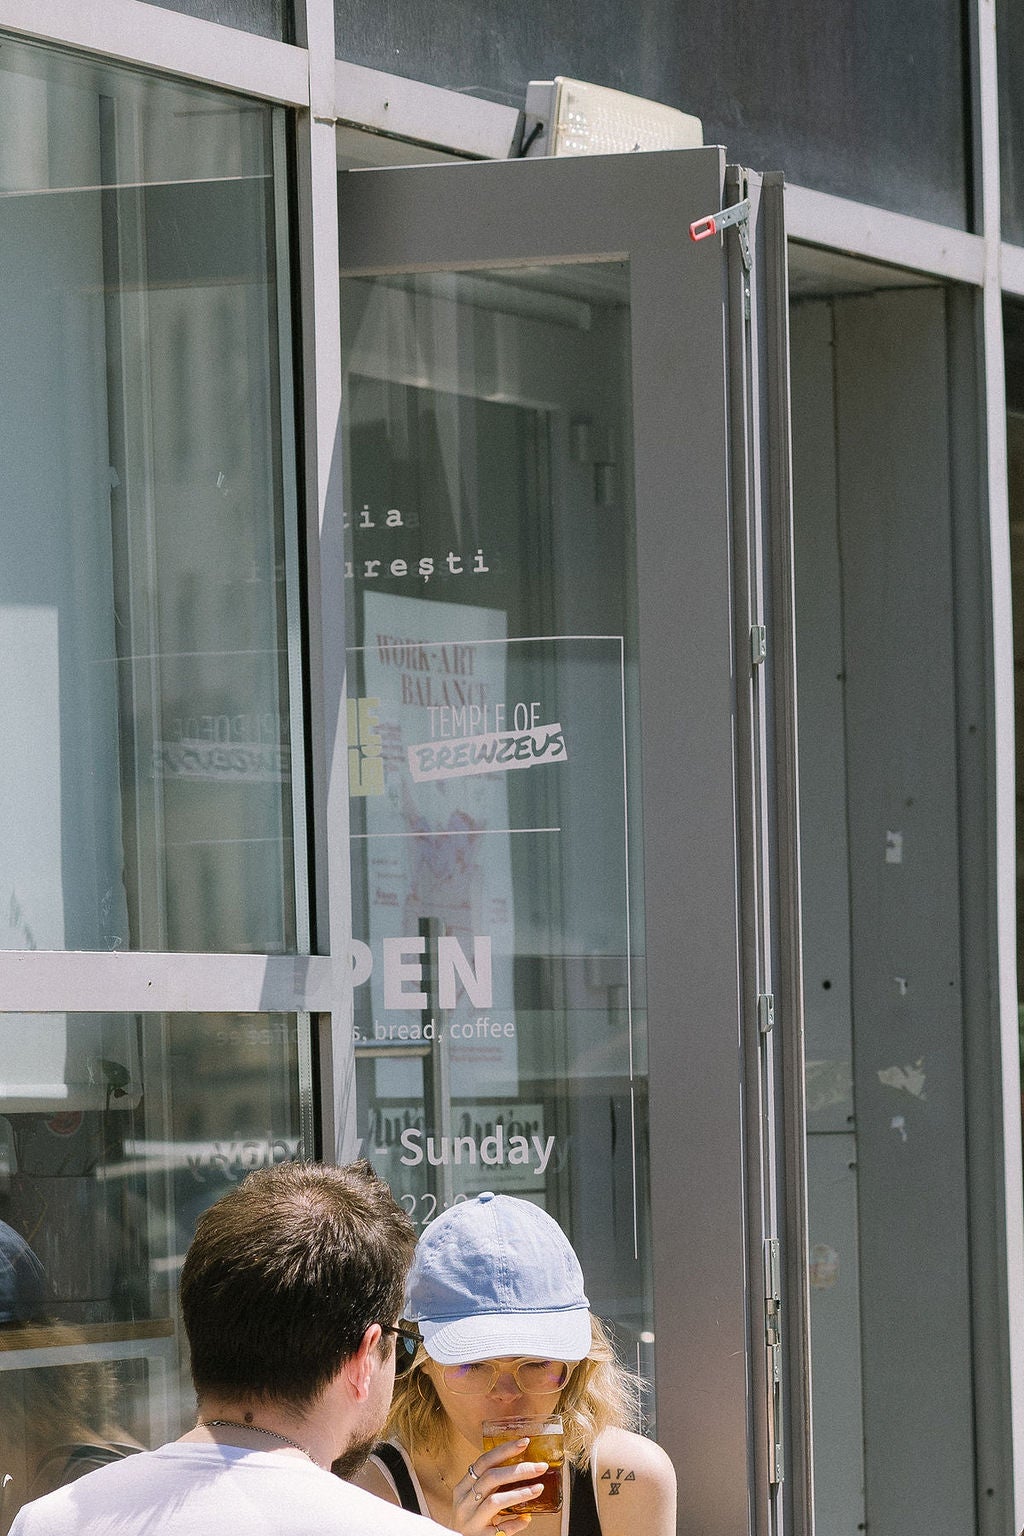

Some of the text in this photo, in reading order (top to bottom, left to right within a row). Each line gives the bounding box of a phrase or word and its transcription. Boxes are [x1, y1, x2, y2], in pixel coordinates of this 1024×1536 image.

[427, 702, 541, 738] TEMPLE OF
[412, 729, 566, 776] BREWZEUS
[450, 1017, 515, 1039] coffee
[400, 1124, 555, 1175] Sunday
